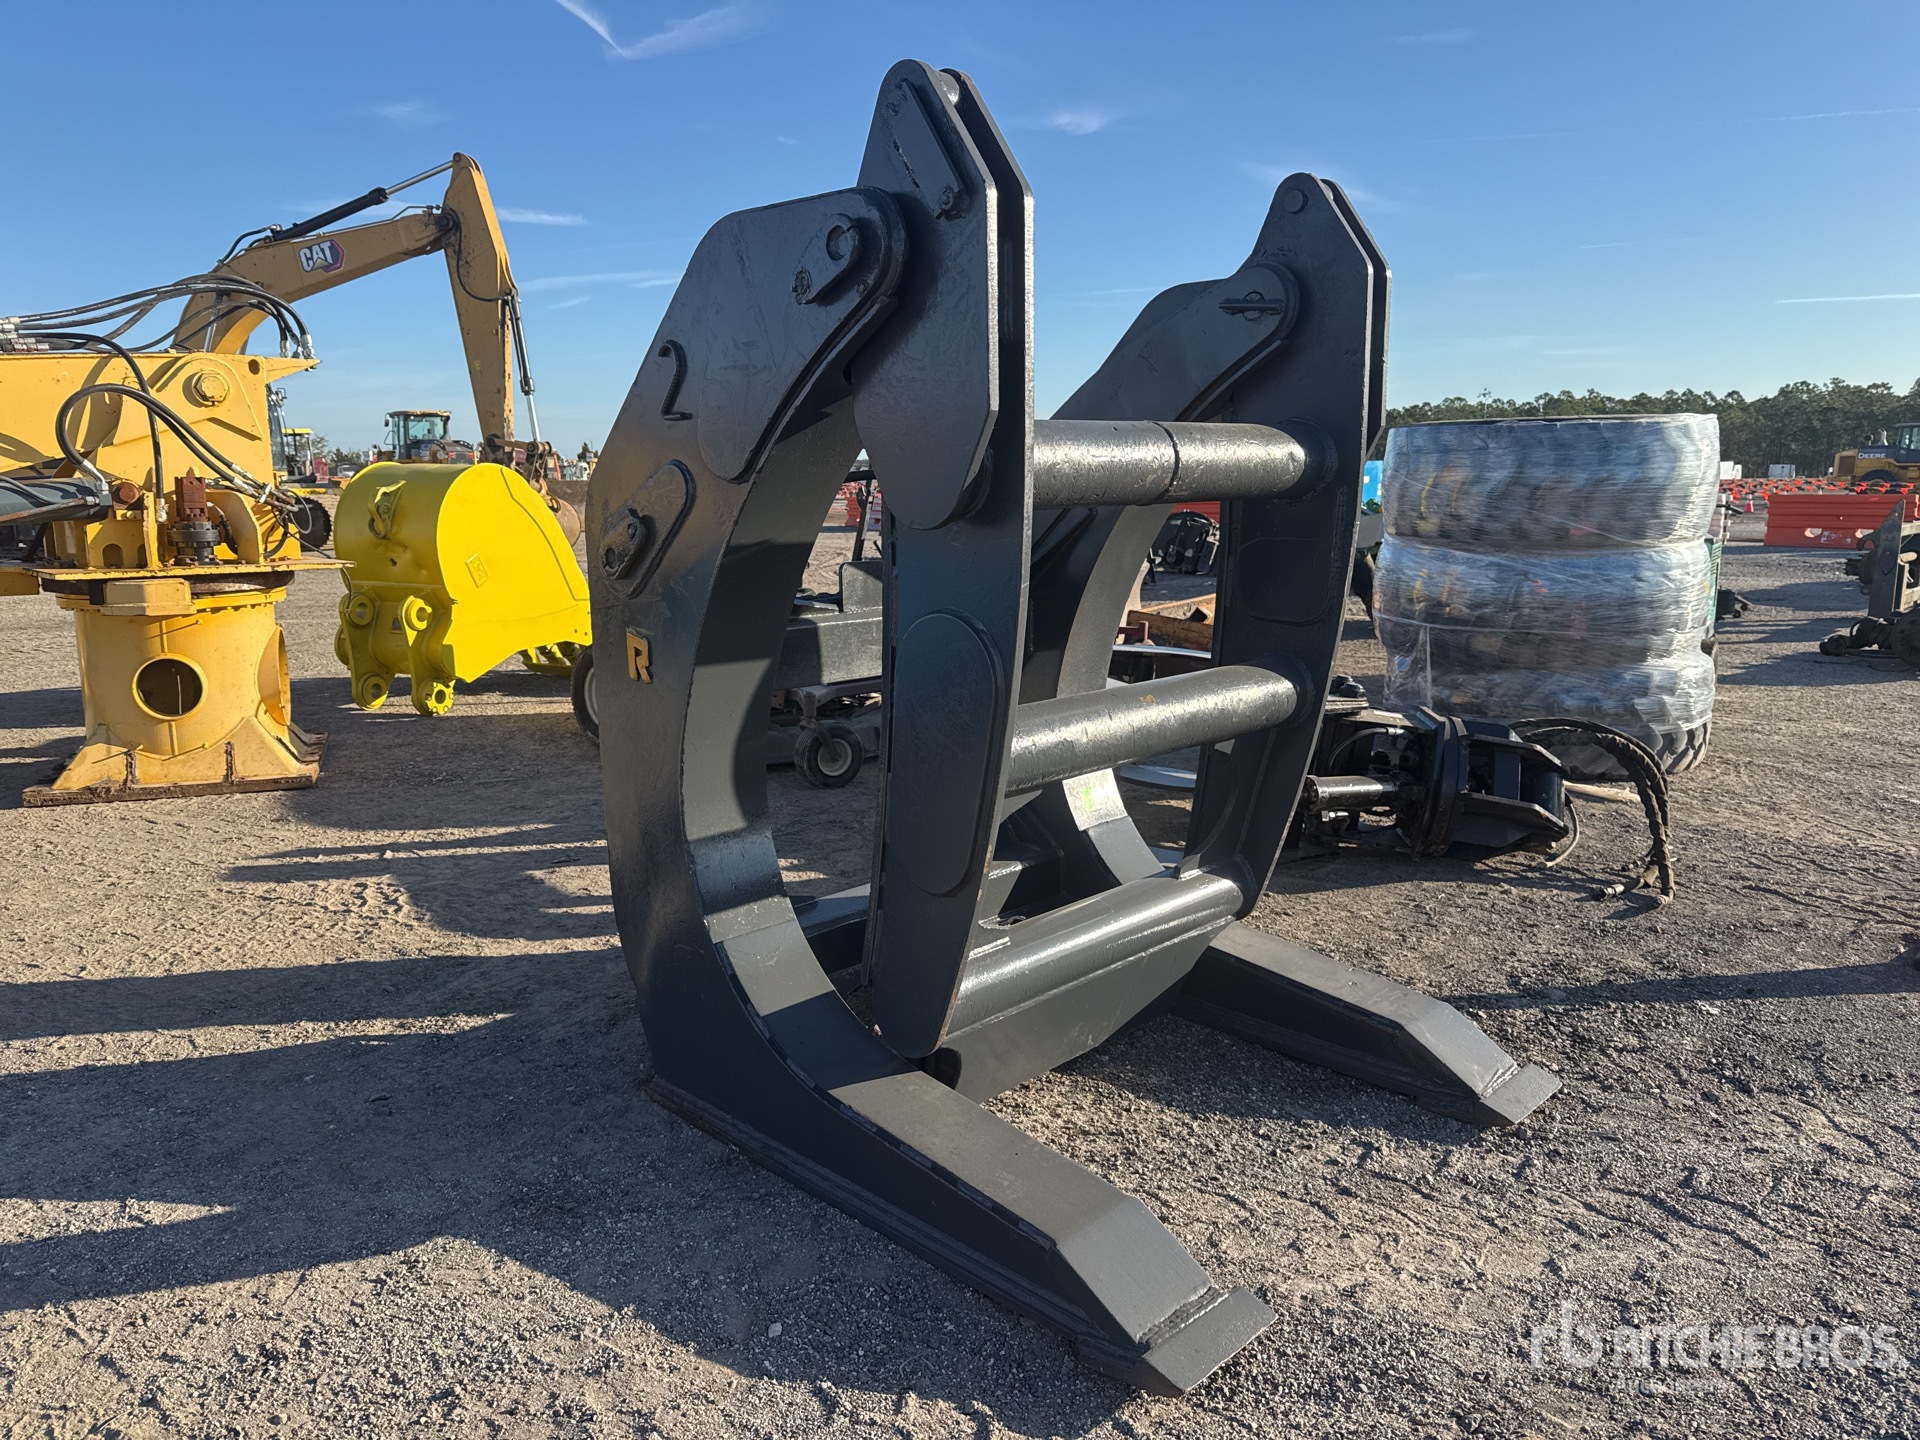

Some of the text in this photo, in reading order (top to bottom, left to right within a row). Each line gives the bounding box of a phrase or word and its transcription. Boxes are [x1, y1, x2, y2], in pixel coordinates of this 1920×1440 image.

[299, 240, 334, 272] CAT
[657, 339, 693, 421] 2
[626, 631, 652, 684] R
